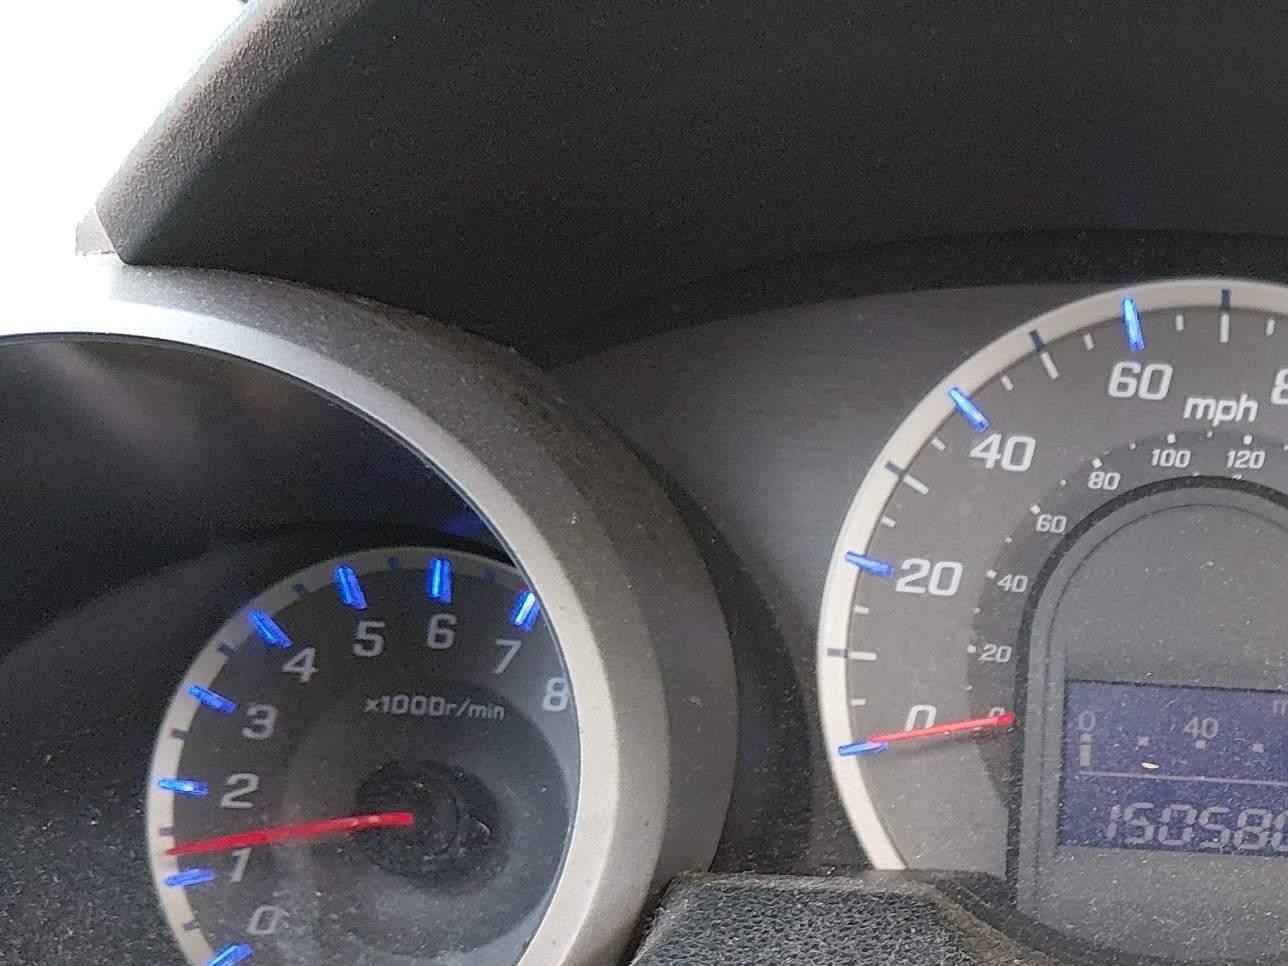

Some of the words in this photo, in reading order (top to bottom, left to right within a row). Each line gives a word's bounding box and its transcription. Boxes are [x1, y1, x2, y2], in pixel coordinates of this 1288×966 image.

[1108, 361, 1173, 400] 60
[1183, 393, 1259, 426] mph
[969, 433, 1037, 472] 40
[1151, 449, 1192, 468] 100
[1226, 450, 1266, 469] 120
[1088, 471, 1121, 491] 80
[1035, 514, 1068, 533] 60
[895, 558, 963, 596] 20
[997, 574, 1029, 593] 40
[352, 620, 386, 657] 5
[426, 613, 458, 650] 6
[282, 646, 318, 684] 4
[494, 638, 522, 675] 7
[978, 643, 1012, 663] 20
[543, 677, 570, 712] 8
[242, 704, 278, 739] 3
[1078, 711, 1096, 732] 0
[1184, 716, 1219, 739] 40
[220, 773, 260, 809] 2
[230, 847, 252, 883] 1
[248, 905, 280, 936] 0
